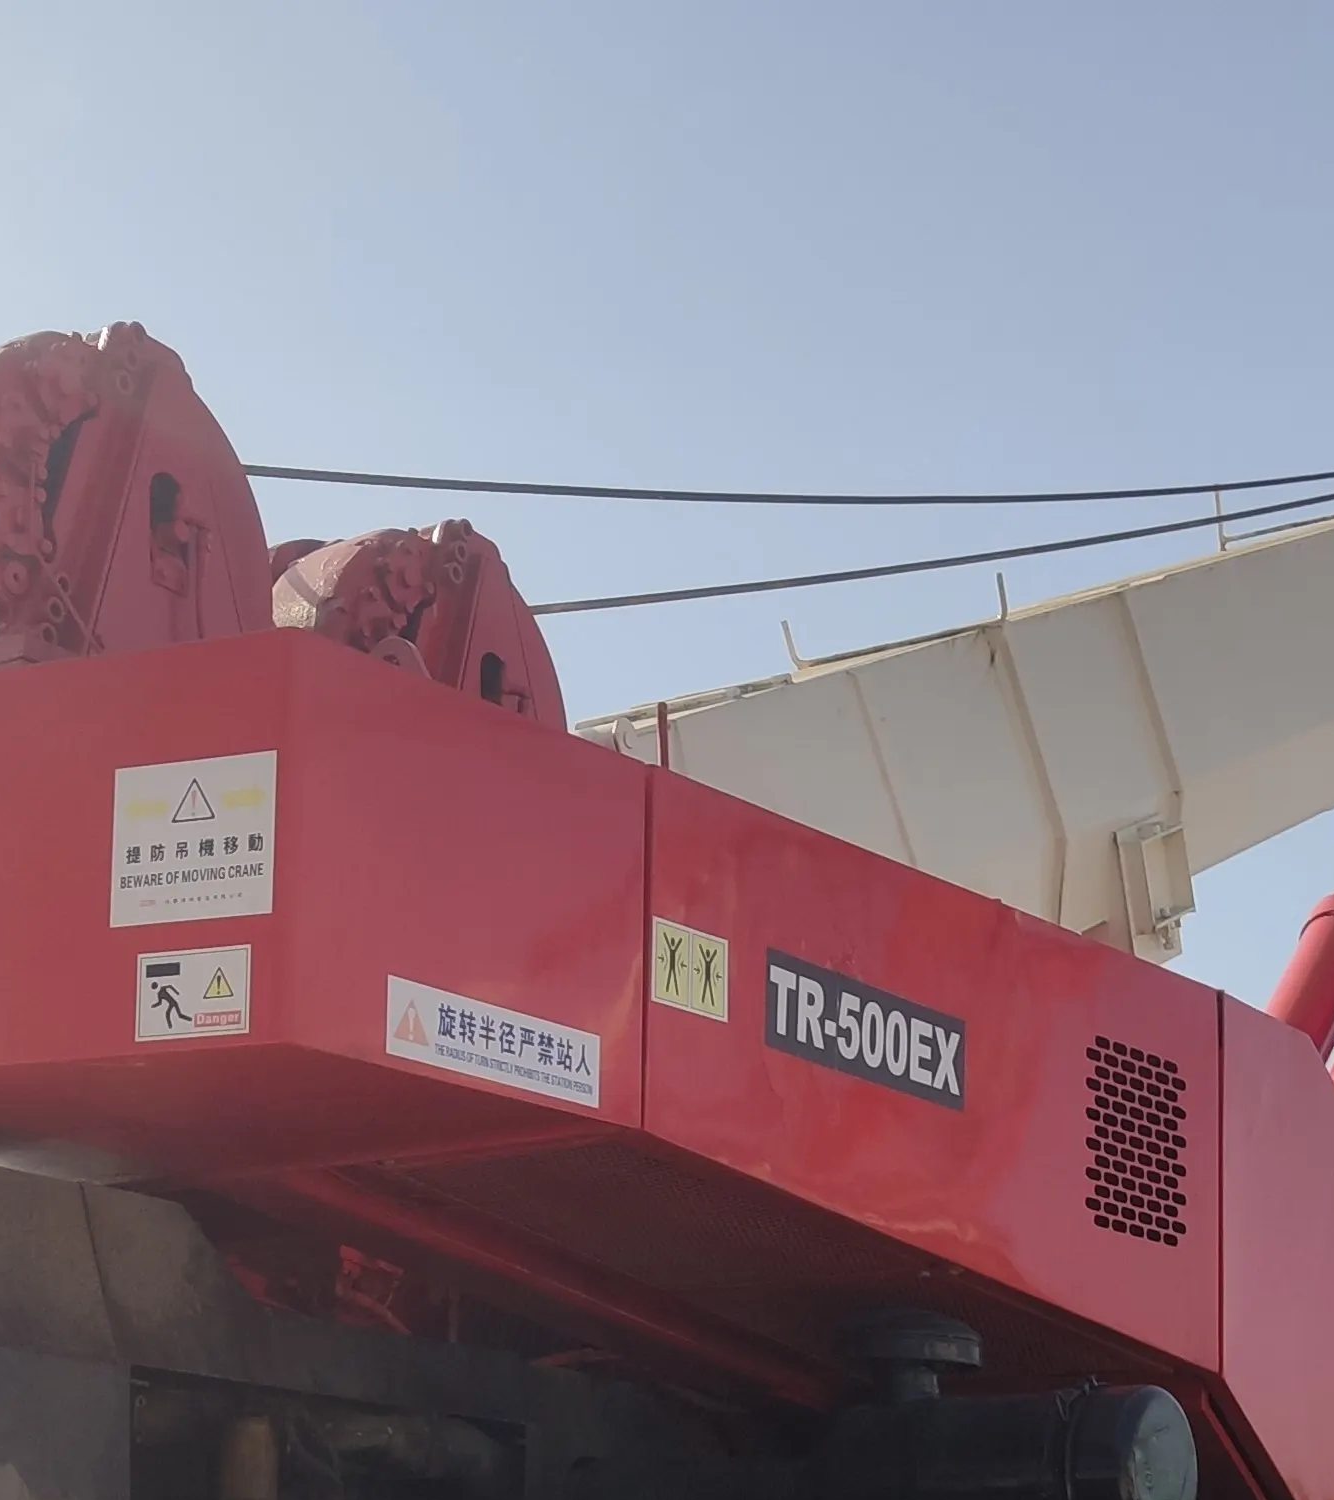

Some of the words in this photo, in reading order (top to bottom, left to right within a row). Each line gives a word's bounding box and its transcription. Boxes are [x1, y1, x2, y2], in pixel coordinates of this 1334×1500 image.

[120, 872, 163, 889] BEWARE
[165, 871, 180, 885] OF
[181, 867, 225, 883] MOVING
[228, 863, 264, 879] CRANE
[196, 1013, 239, 1025] Danger
[437, 1002, 591, 1076] 旋转半径严禁站人
[769, 964, 960, 1096] TR-500EX
